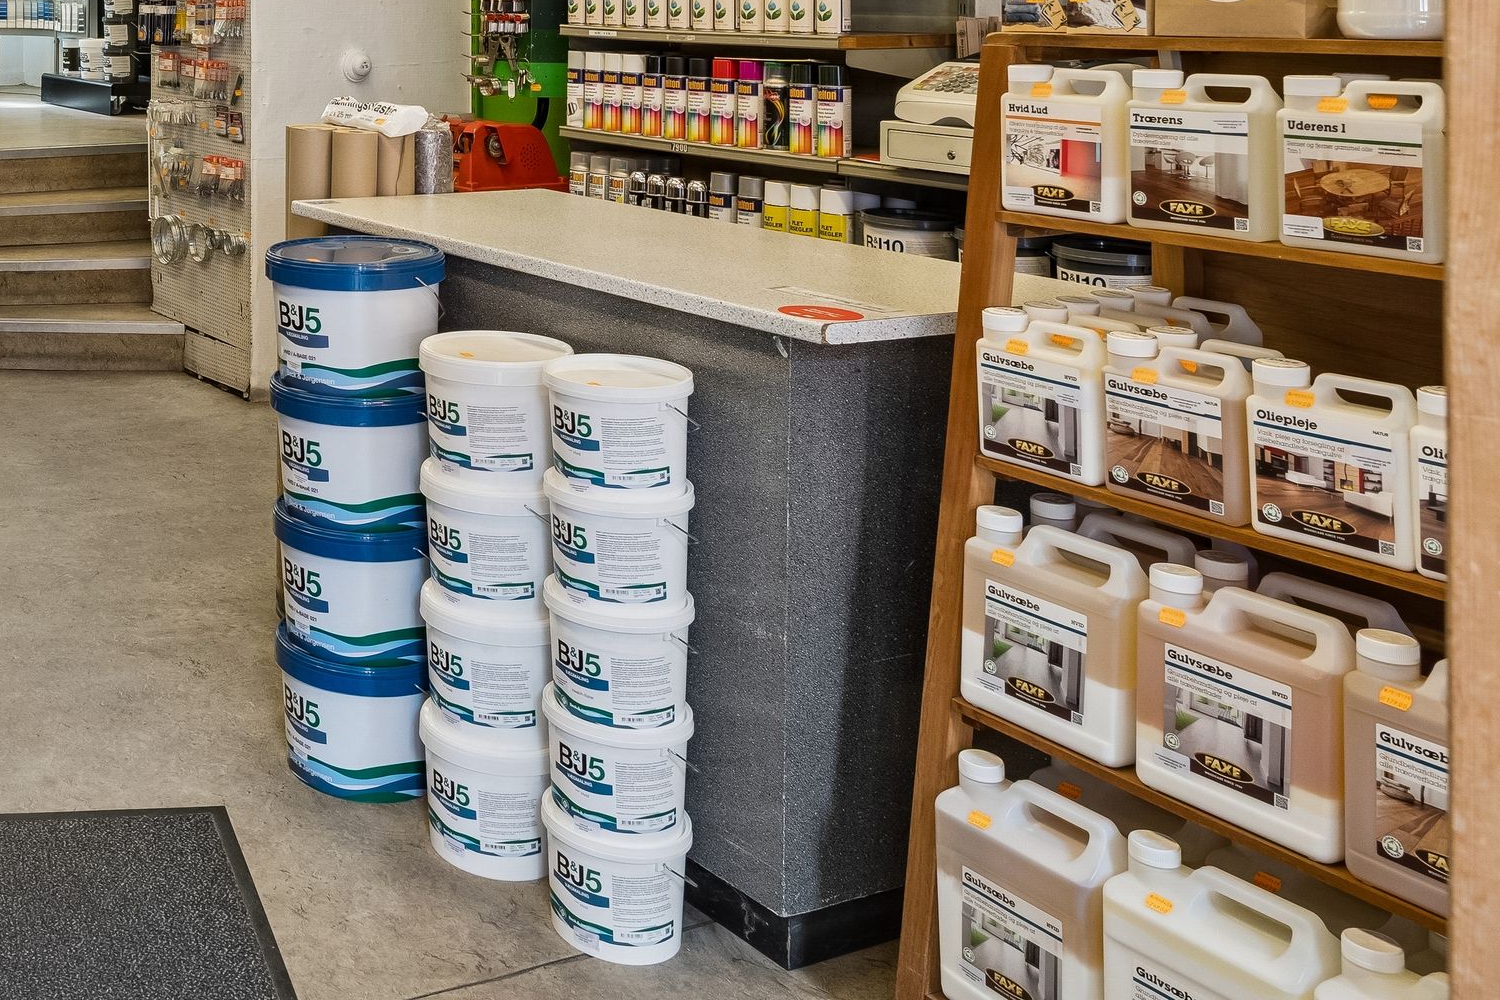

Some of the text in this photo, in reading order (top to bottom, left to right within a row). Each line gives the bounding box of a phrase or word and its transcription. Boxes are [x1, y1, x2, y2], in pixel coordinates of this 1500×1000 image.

[1008, 103, 1048, 115] Hvid Lud
[1132, 113, 1183, 125] Trærens
[1287, 119, 1337, 133] Uderens
[1036, 186, 1065, 199] FAXE
[1169, 201, 1204, 216] FAXE
[278, 300, 322, 334] B&J5
[982, 352, 1035, 372] Gulvsæbe
[1107, 379, 1168, 400] Gulvsæbe
[429, 394, 460, 424] B&J5
[553, 404, 592, 438] B&J5
[1256, 408, 1318, 431] Oliepleje
[1015, 440, 1044, 456] FAXE
[1372, 430, 1389, 438] NATUR
[282, 430, 322, 467] B&J5
[1145, 474, 1180, 491] FAXE
[430, 517, 462, 550] B&J5
[552, 513, 588, 550] B&J5
[1301, 512, 1343, 532] FAXE
[284, 557, 322, 598] B&J5
[987, 584, 1041, 612] Gulvsæbe
[430, 640, 463, 677] B&J5
[558, 638, 601, 677] B&J5
[1167, 649, 1233, 680] Gulvsæbe
[1015, 679, 1045, 700] FAXE
[1271, 690, 1289, 700] HVID
[284, 683, 321, 728] B&J5
[559, 740, 606, 781] B&J5
[1379, 730, 1449, 765] Gulvsæb
[1204, 755, 1242, 779] FAXE
[433, 768, 471, 807] B&J5
[557, 850, 603, 895] B&J5
[964, 871, 1016, 908] Gulvsæbe
[993, 971, 1023, 998] FAXE
